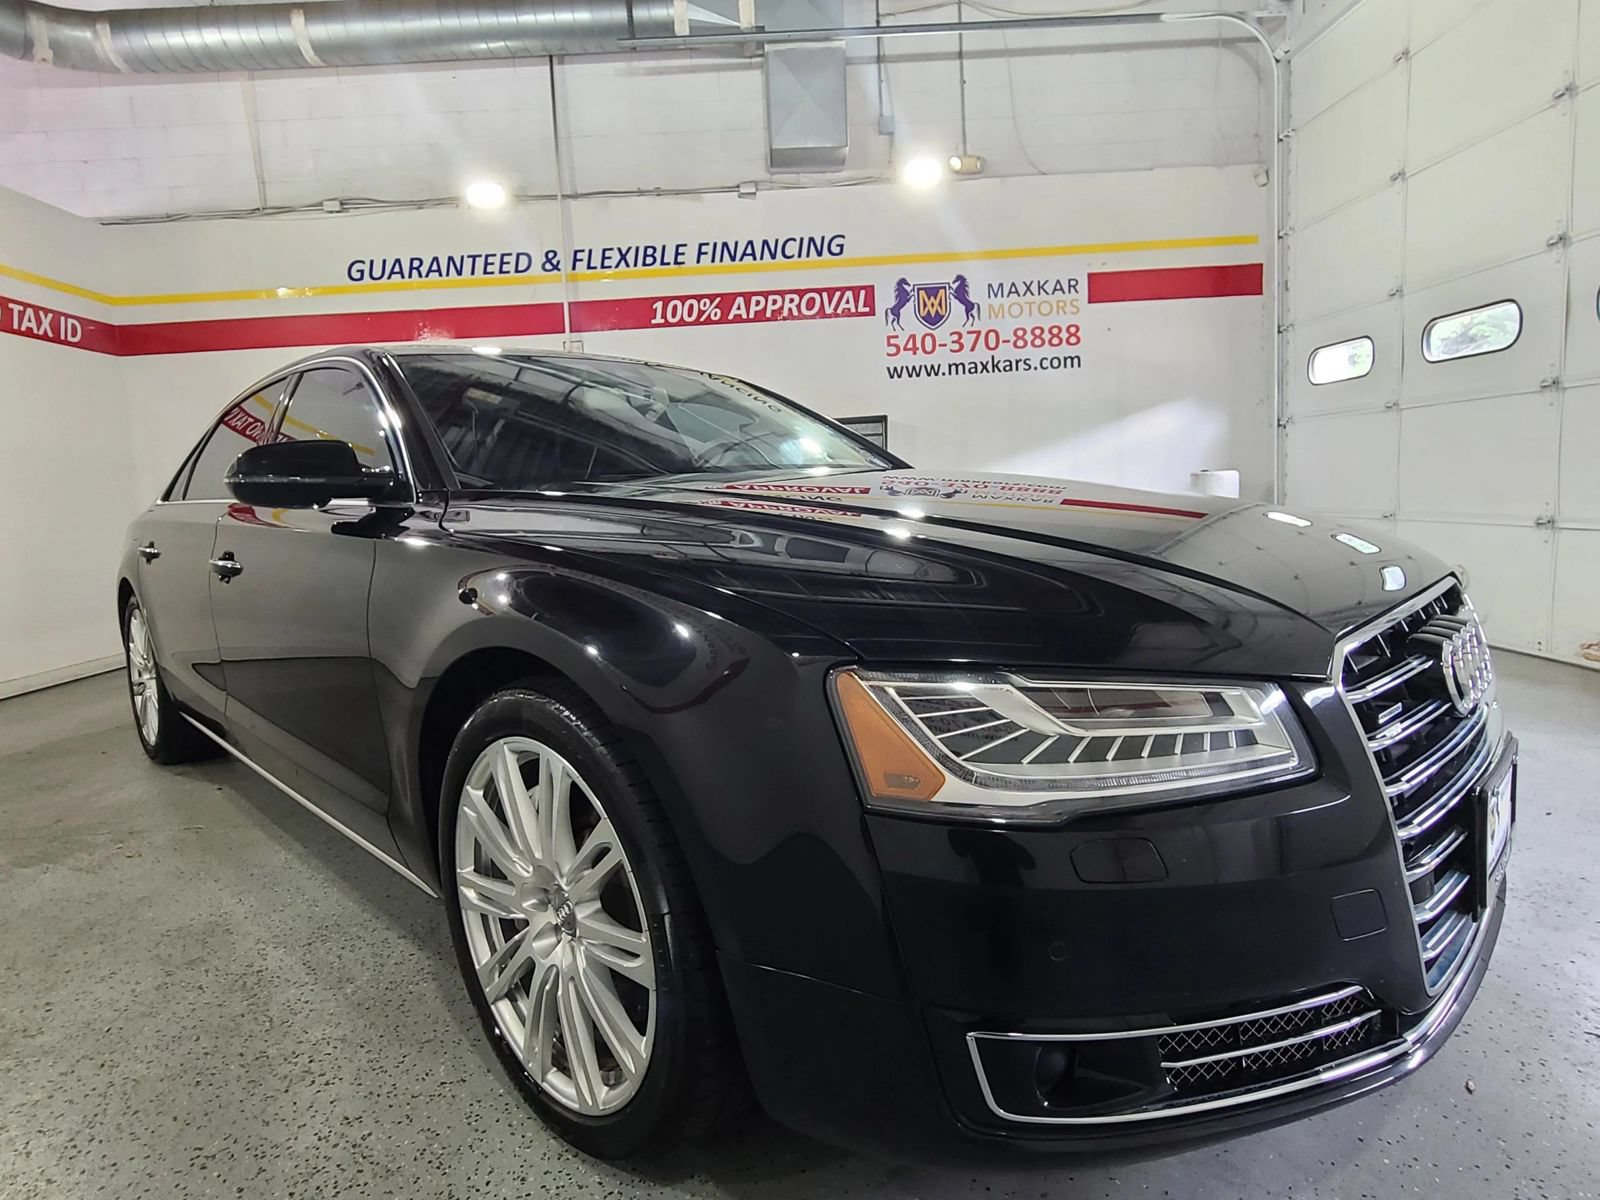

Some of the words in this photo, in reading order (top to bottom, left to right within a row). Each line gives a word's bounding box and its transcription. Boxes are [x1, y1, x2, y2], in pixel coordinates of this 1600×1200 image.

[347, 251, 532, 282] GUARANTEED
[541, 249, 562, 272] &
[571, 243, 687, 271] FLEXIBLE
[696, 234, 846, 264] FINANCING
[987, 278, 1079, 299] MAXKAR
[8, 302, 54, 338] TAX
[60, 315, 82, 343] ID
[650, 296, 721, 324] 100%
[728, 289, 871, 320] APPROVAL
[987, 299, 1081, 320] MOTORS
[886, 323, 1081, 357] 540-370-8888
[886, 355, 1082, 379] www.maxkars.com
